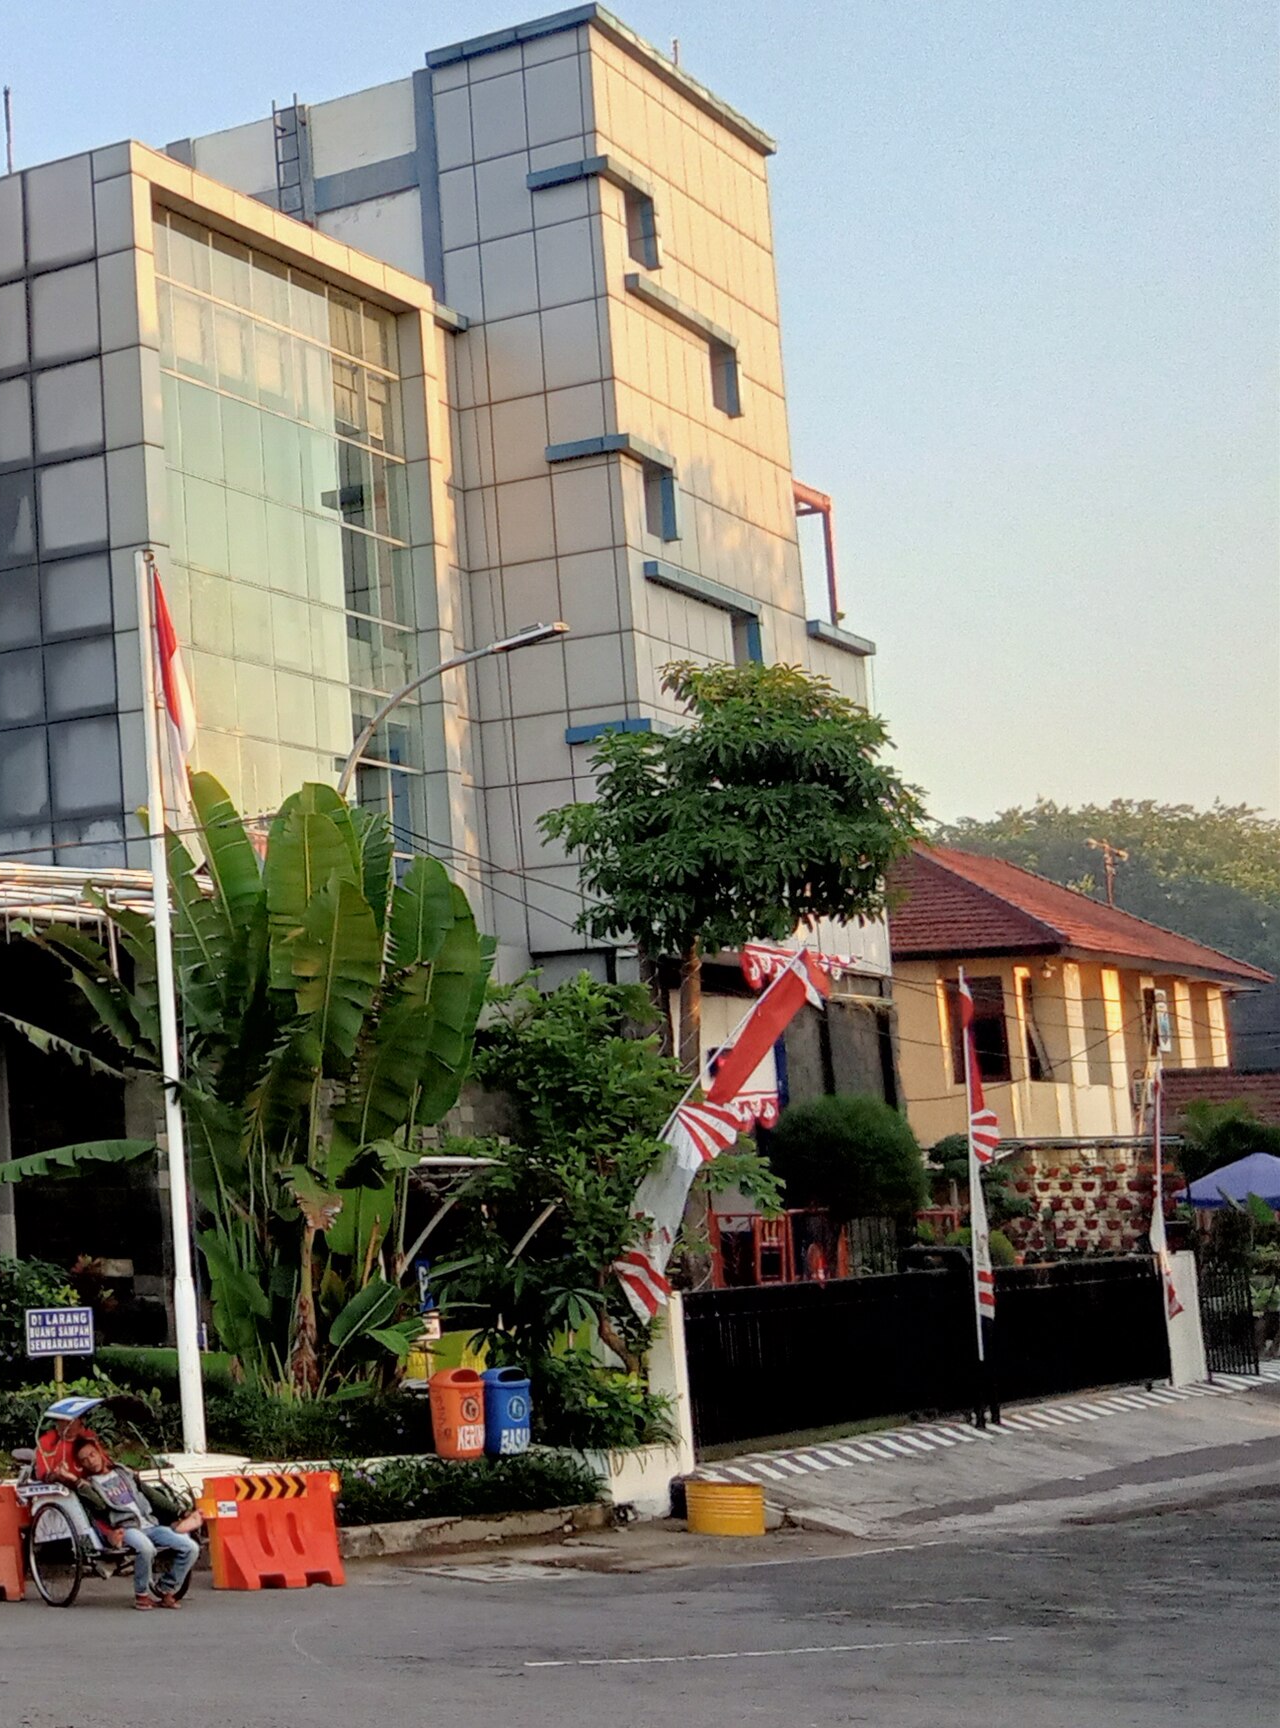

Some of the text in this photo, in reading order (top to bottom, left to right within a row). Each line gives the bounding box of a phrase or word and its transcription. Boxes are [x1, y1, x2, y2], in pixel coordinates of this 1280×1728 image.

[30, 1312, 87, 1326] DI LARANG
[30, 1325, 90, 1338] BUANG SAMPAH
[30, 1338, 90, 1351] SEMBARANGAN
